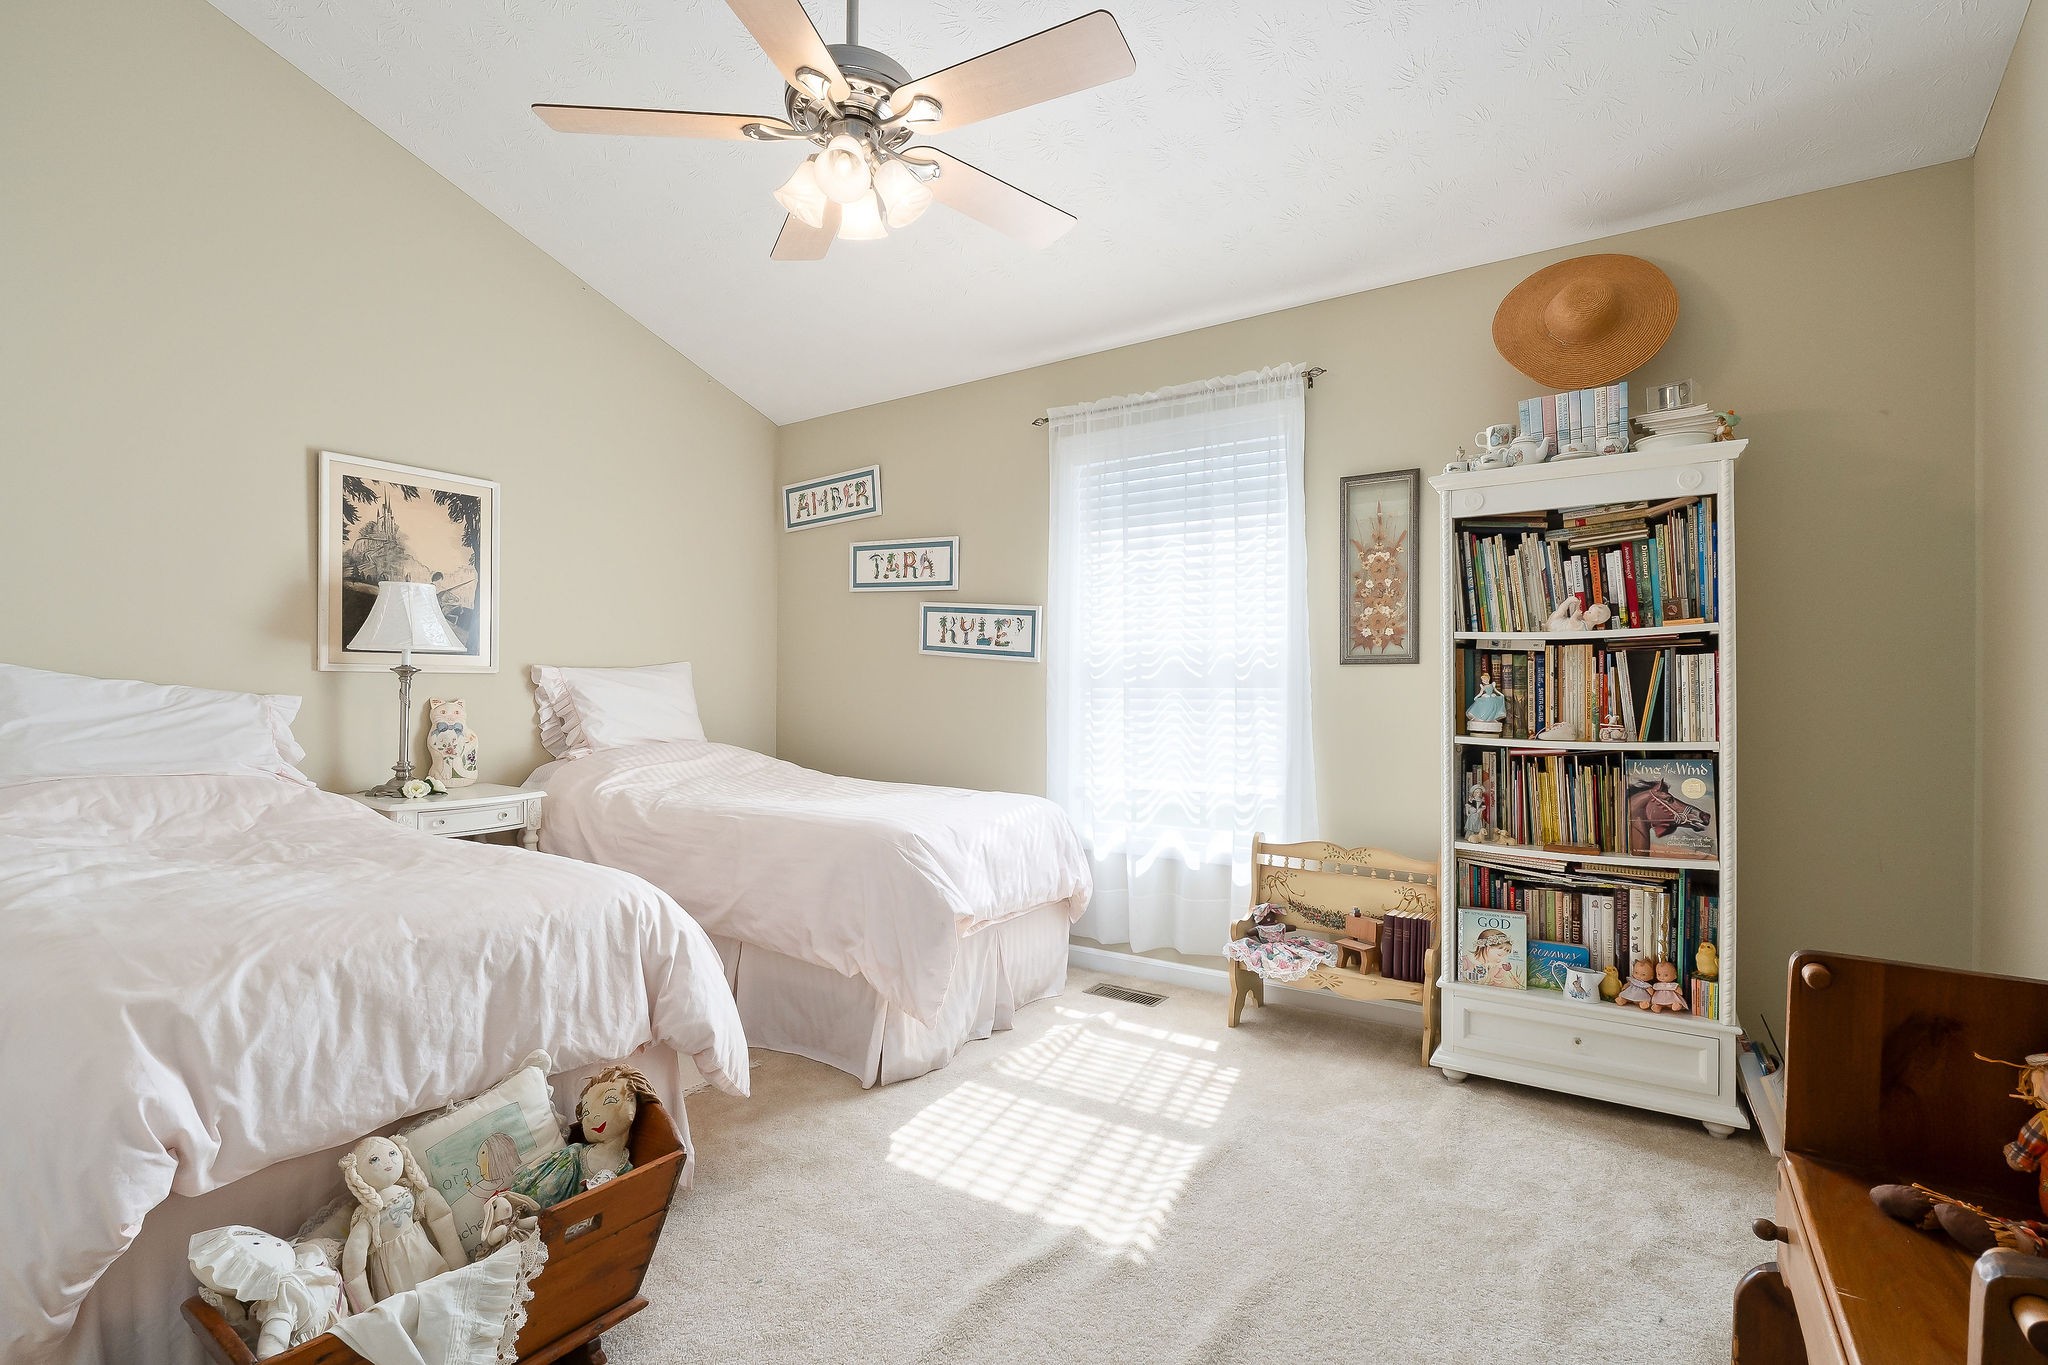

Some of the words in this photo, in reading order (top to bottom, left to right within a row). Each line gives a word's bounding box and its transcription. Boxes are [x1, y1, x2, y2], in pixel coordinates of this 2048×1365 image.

[796, 480, 869, 518] AMBER
[868, 550, 936, 580] TARA
[1630, 762, 1662, 778] King
[1676, 762, 1708, 776] Wind
[1478, 917, 1510, 929] GOD
[1530, 948, 1581, 960] RUNAWAY
[460, 1220, 485, 1242] che
